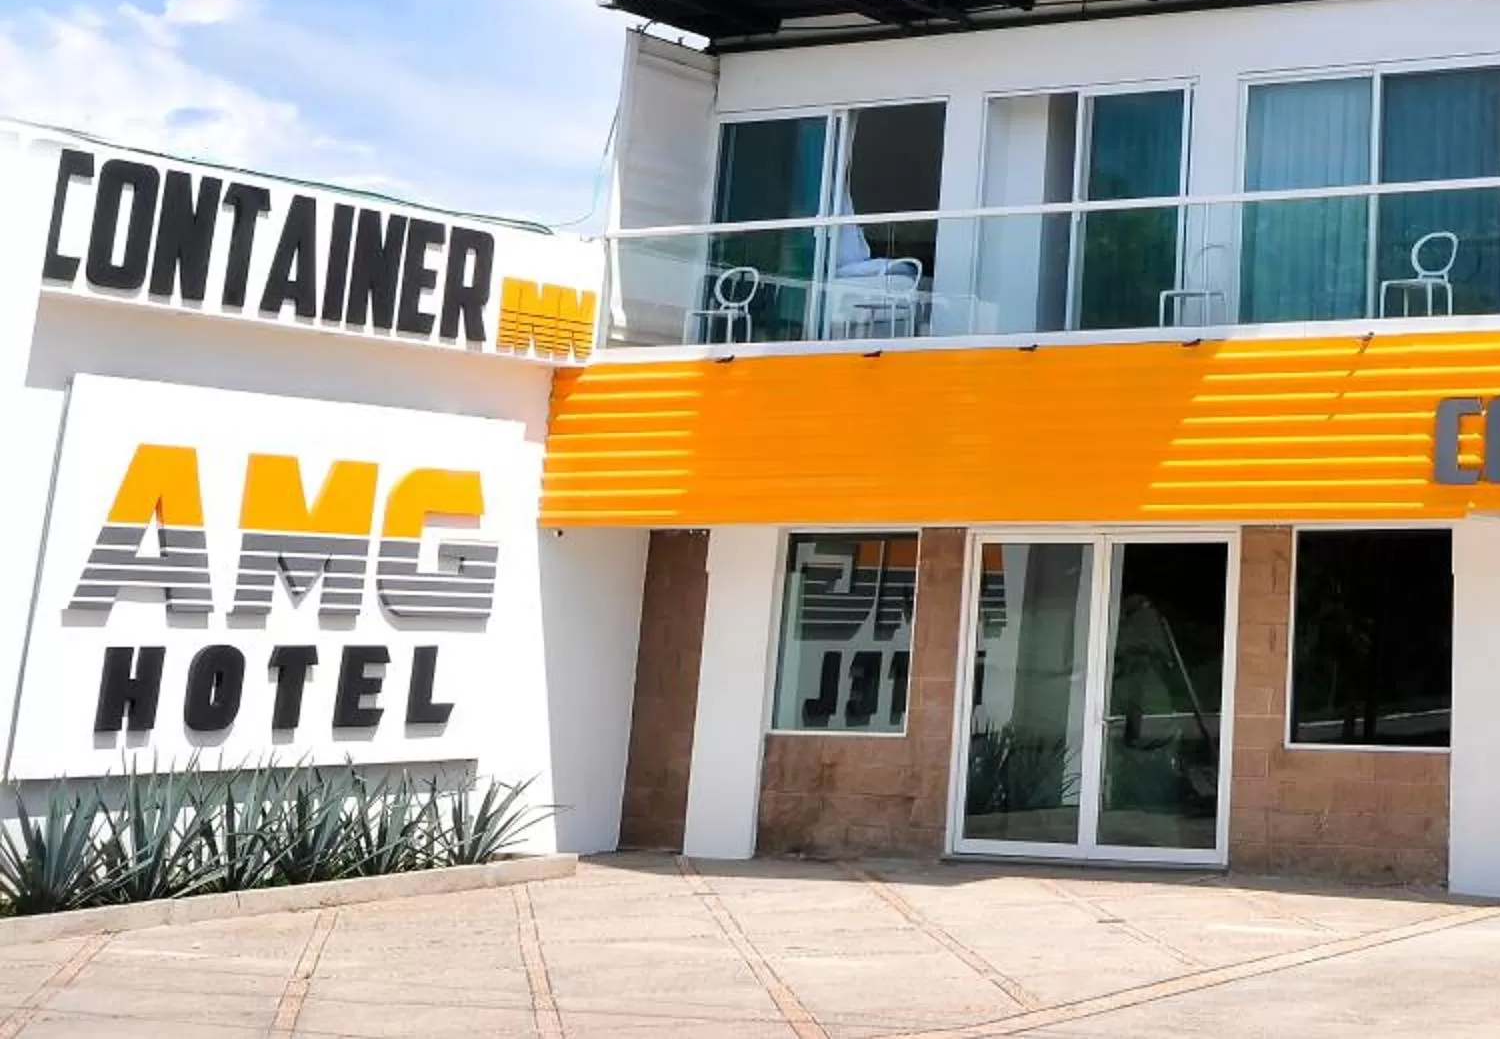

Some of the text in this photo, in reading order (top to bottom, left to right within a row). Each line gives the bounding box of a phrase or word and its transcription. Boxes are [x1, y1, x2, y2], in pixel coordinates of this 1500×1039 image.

[42, 148, 596, 358] CONTAINER INN
[66, 442, 499, 618] AMG
[94, 644, 455, 732] HOTEL
